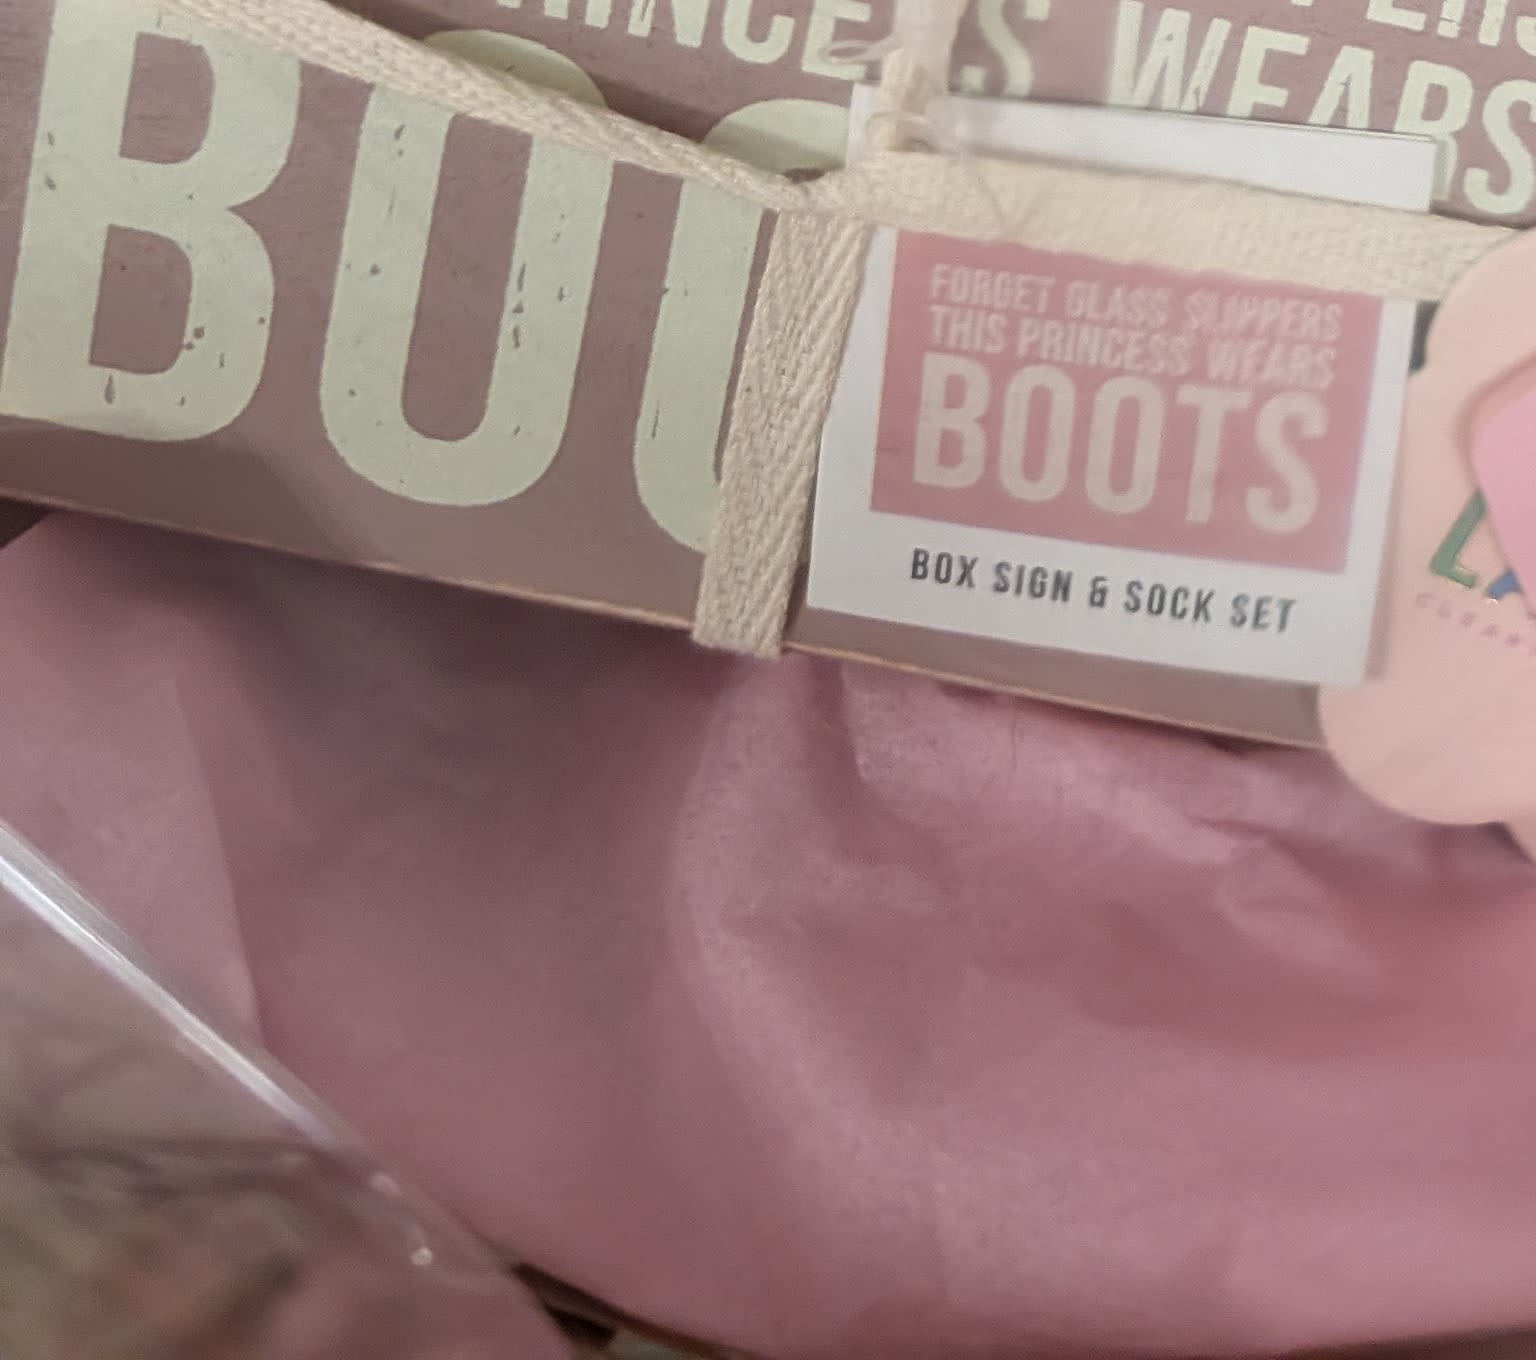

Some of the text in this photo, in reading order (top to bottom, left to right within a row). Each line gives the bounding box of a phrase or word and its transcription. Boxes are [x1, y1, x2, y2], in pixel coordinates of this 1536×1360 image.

[930, 262, 1343, 342] FORGET GLASS SLIPPERS
[928, 305, 1336, 392] THIS PRINCESS WEARS
[911, 350, 1331, 534] BOOTS
[910, 547, 1297, 633] BOX SIGN & SOCK SET
